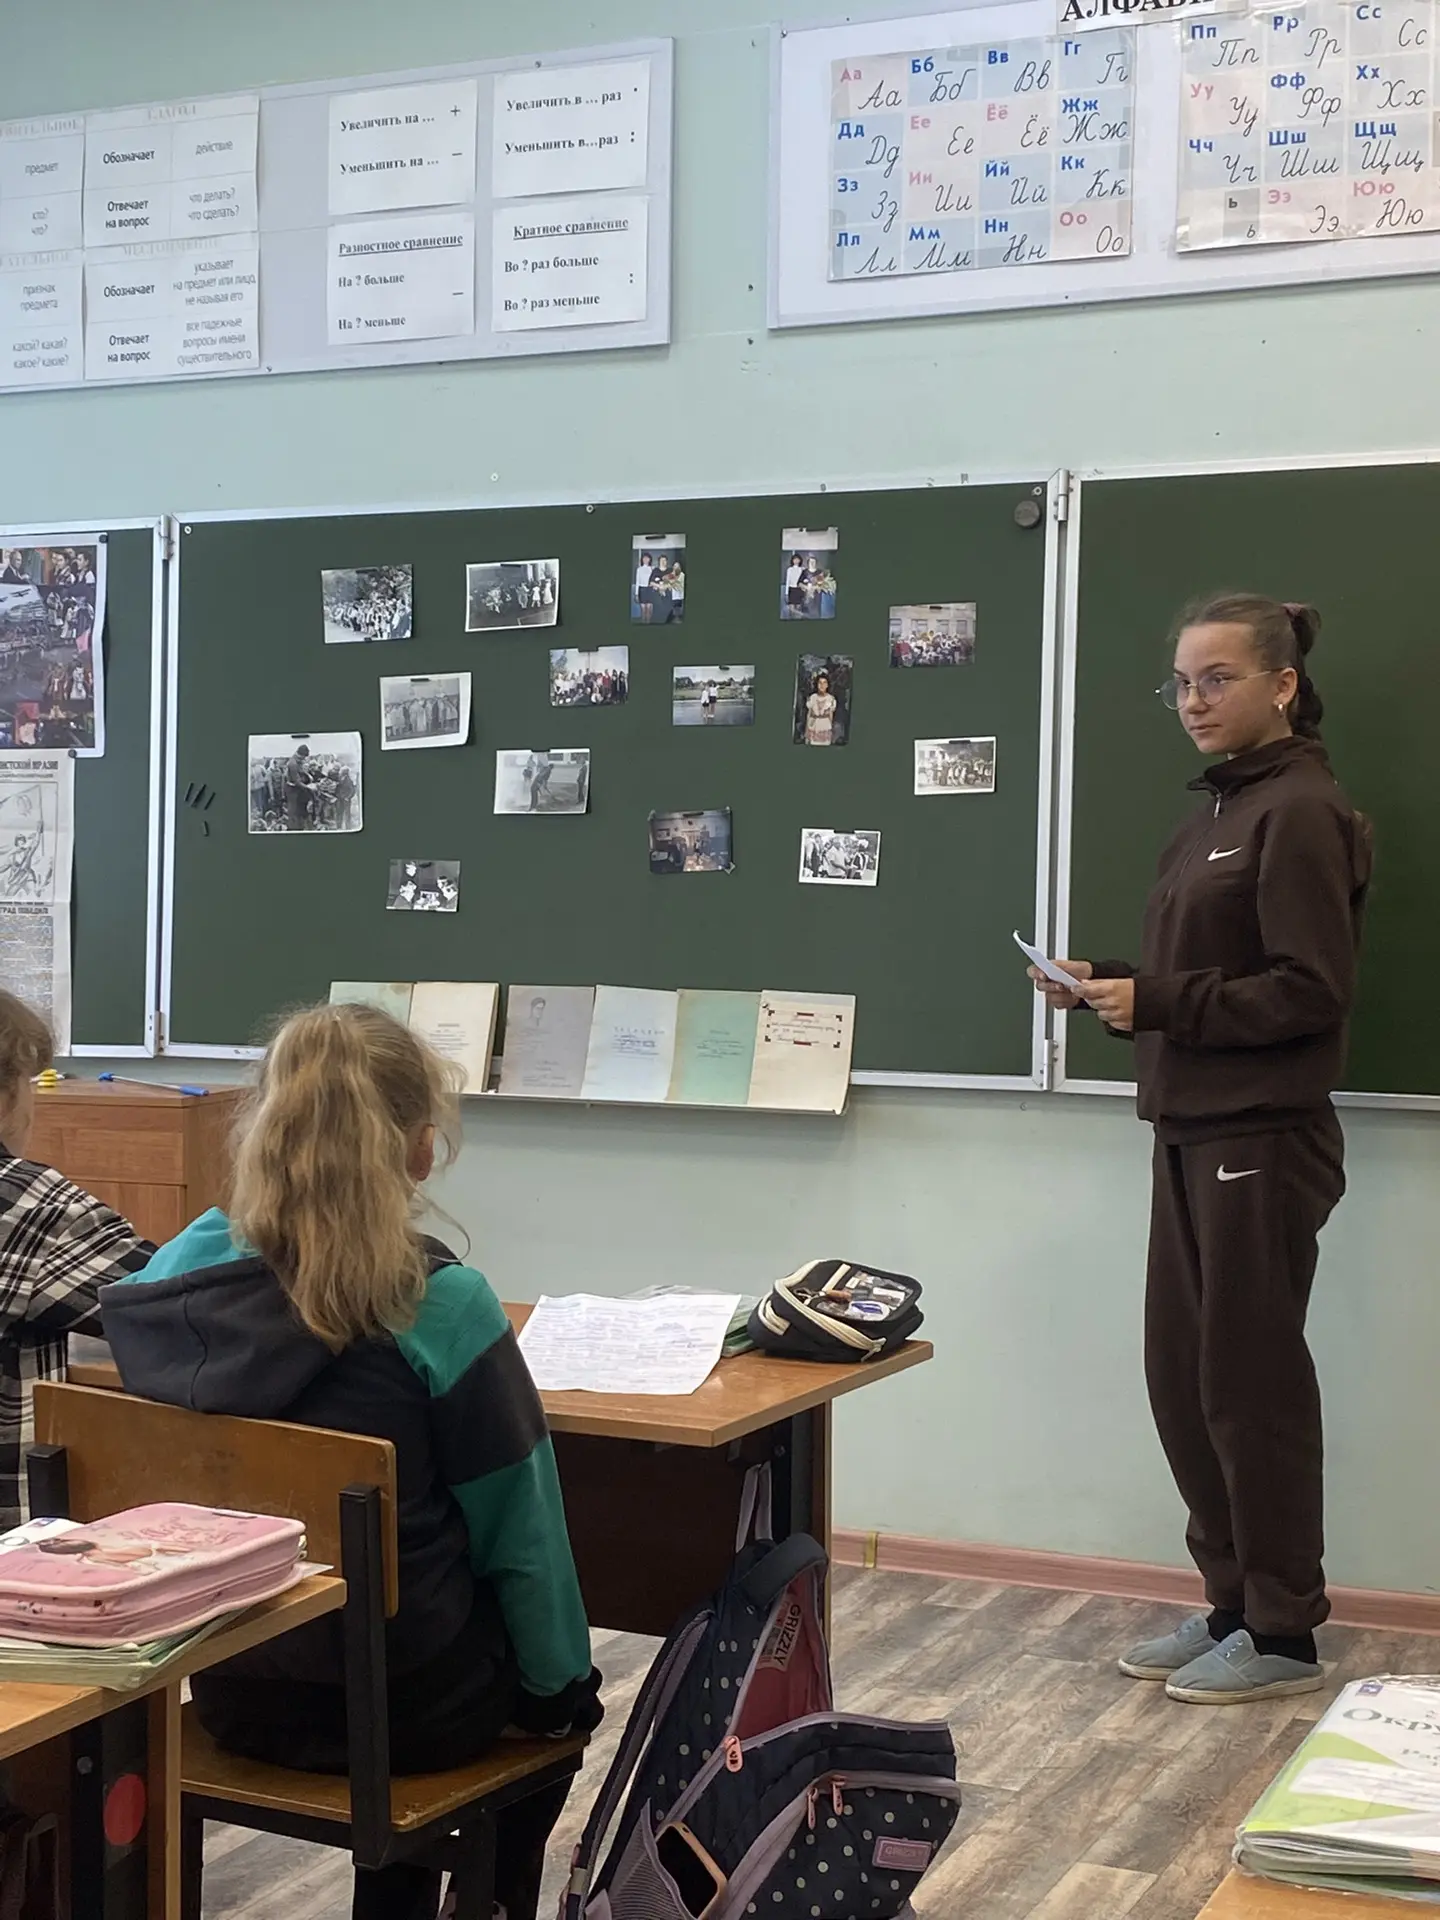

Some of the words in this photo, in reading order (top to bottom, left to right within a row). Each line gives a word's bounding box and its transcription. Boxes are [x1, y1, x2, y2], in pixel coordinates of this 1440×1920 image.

[1356, 5, 1382, 20] Сс
[1273, 16, 1299, 32] Рр
[1192, 25, 1216, 40] Пп
[1064, 42, 1081, 56] Гг
[912, 56, 934, 74] Бб
[988, 51, 1009, 64] Вв
[840, 68, 862, 82] Аа
[1356, 65, 1380, 80] Хх
[1270, 72, 1306, 90] Фф
[1190, 84, 1214, 100] Уу
[507, 96, 571, 112] Увеличить
[601, 90, 622, 104] раз
[1062, 99, 1098, 113] Жж
[986, 105, 1008, 120] Ёё
[340, 116, 401, 131] Увеличить
[405, 114, 419, 124] на
[910, 116, 930, 130] Ее
[838, 123, 864, 139] Дд
[1355, 122, 1396, 139] Щщ
[504, 138, 575, 154] Уменьшить
[1268, 131, 1306, 146] Шш
[1189, 139, 1213, 154] Чч
[103, 150, 155, 164] Обозначает
[1061, 156, 1084, 170] Кк
[25, 163, 58, 176] предмет
[340, 159, 406, 174] Уменьшить
[410, 157, 423, 168] на
[985, 161, 1010, 176] Йй
[837, 178, 858, 192] Зз
[909, 171, 932, 184] Ии
[1354, 181, 1394, 196] Юю
[1268, 190, 1291, 204] Ээ
[108, 200, 148, 212] Отвечает
[105, 219, 116, 228] на
[119, 216, 150, 229] вопрос
[984, 219, 1008, 232] Нн
[1060, 212, 1087, 226] Оо
[514, 224, 562, 238] Кратное
[565, 218, 628, 234] сравнение
[909, 226, 940, 240] Мм
[338, 240, 400, 254] Разностное
[404, 234, 463, 250] сравнение
[836, 233, 860, 247] Лл
[504, 262, 520, 272] Во
[531, 258, 550, 272] раз
[553, 255, 598, 268] больше
[338, 277, 352, 288] На
[364, 274, 404, 286] больше
[104, 284, 155, 297] Обозначает
[504, 300, 518, 310] Во
[530, 298, 550, 311] раз
[553, 294, 600, 308] меньше
[338, 319, 352, 330] На
[364, 316, 406, 328] меньше
[109, 334, 150, 346] Отвечает
[108, 354, 118, 362] на
[120, 350, 150, 363] вопрос
[774, 1604, 801, 1666] GRIZZLY
